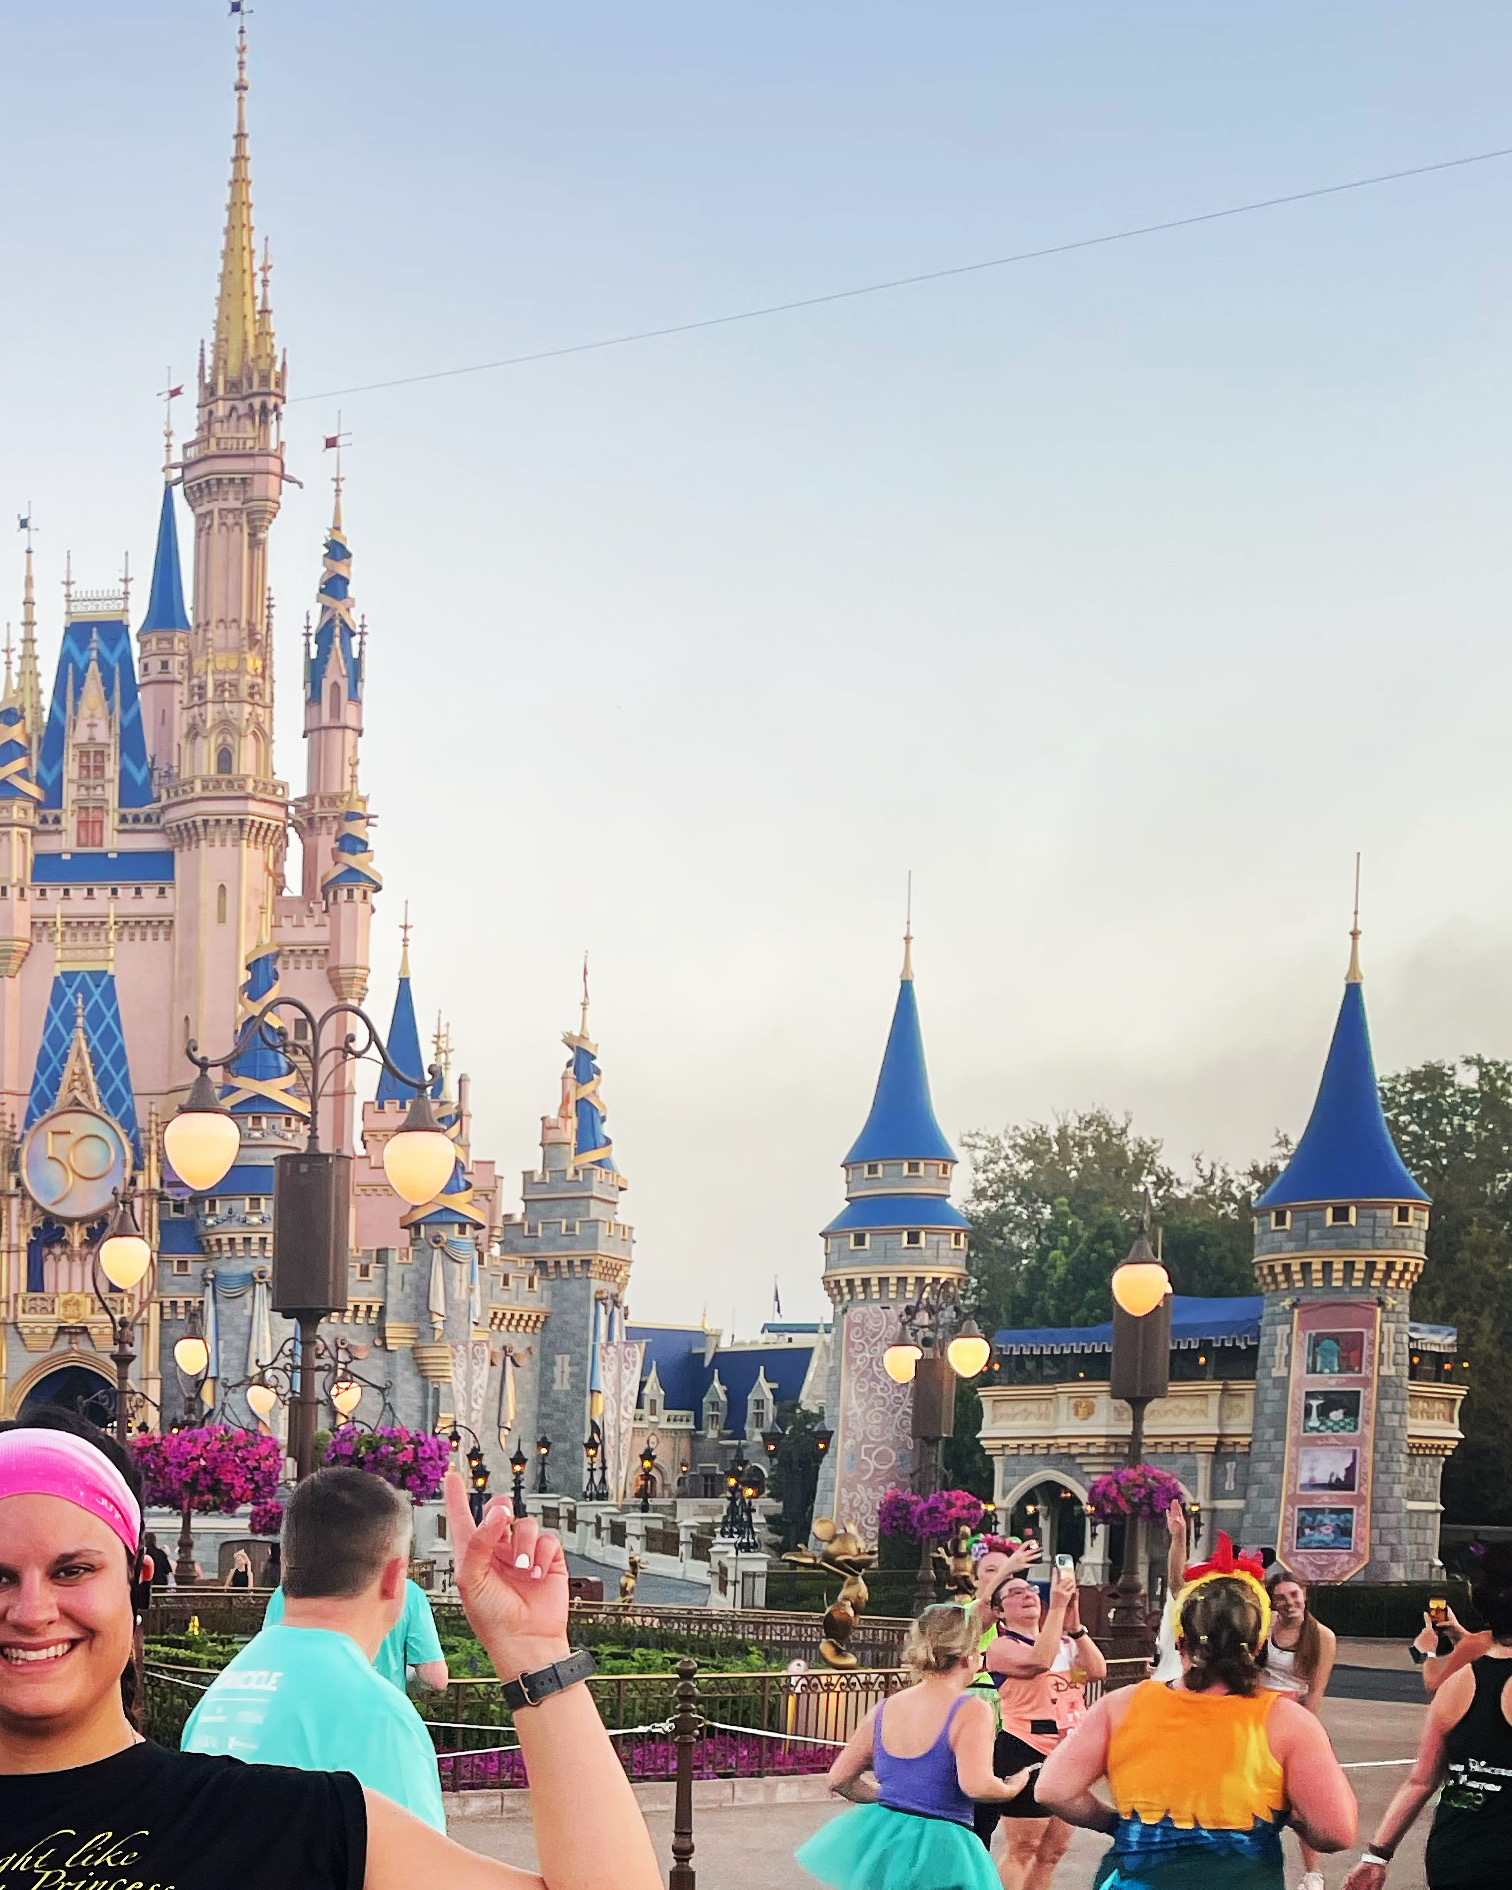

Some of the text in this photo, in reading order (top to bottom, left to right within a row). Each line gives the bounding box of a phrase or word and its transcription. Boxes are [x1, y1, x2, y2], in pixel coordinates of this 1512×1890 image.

[47, 1130, 116, 1206] 50
[861, 1444, 896, 1480] 50
[65, 1830, 150, 1868] like
